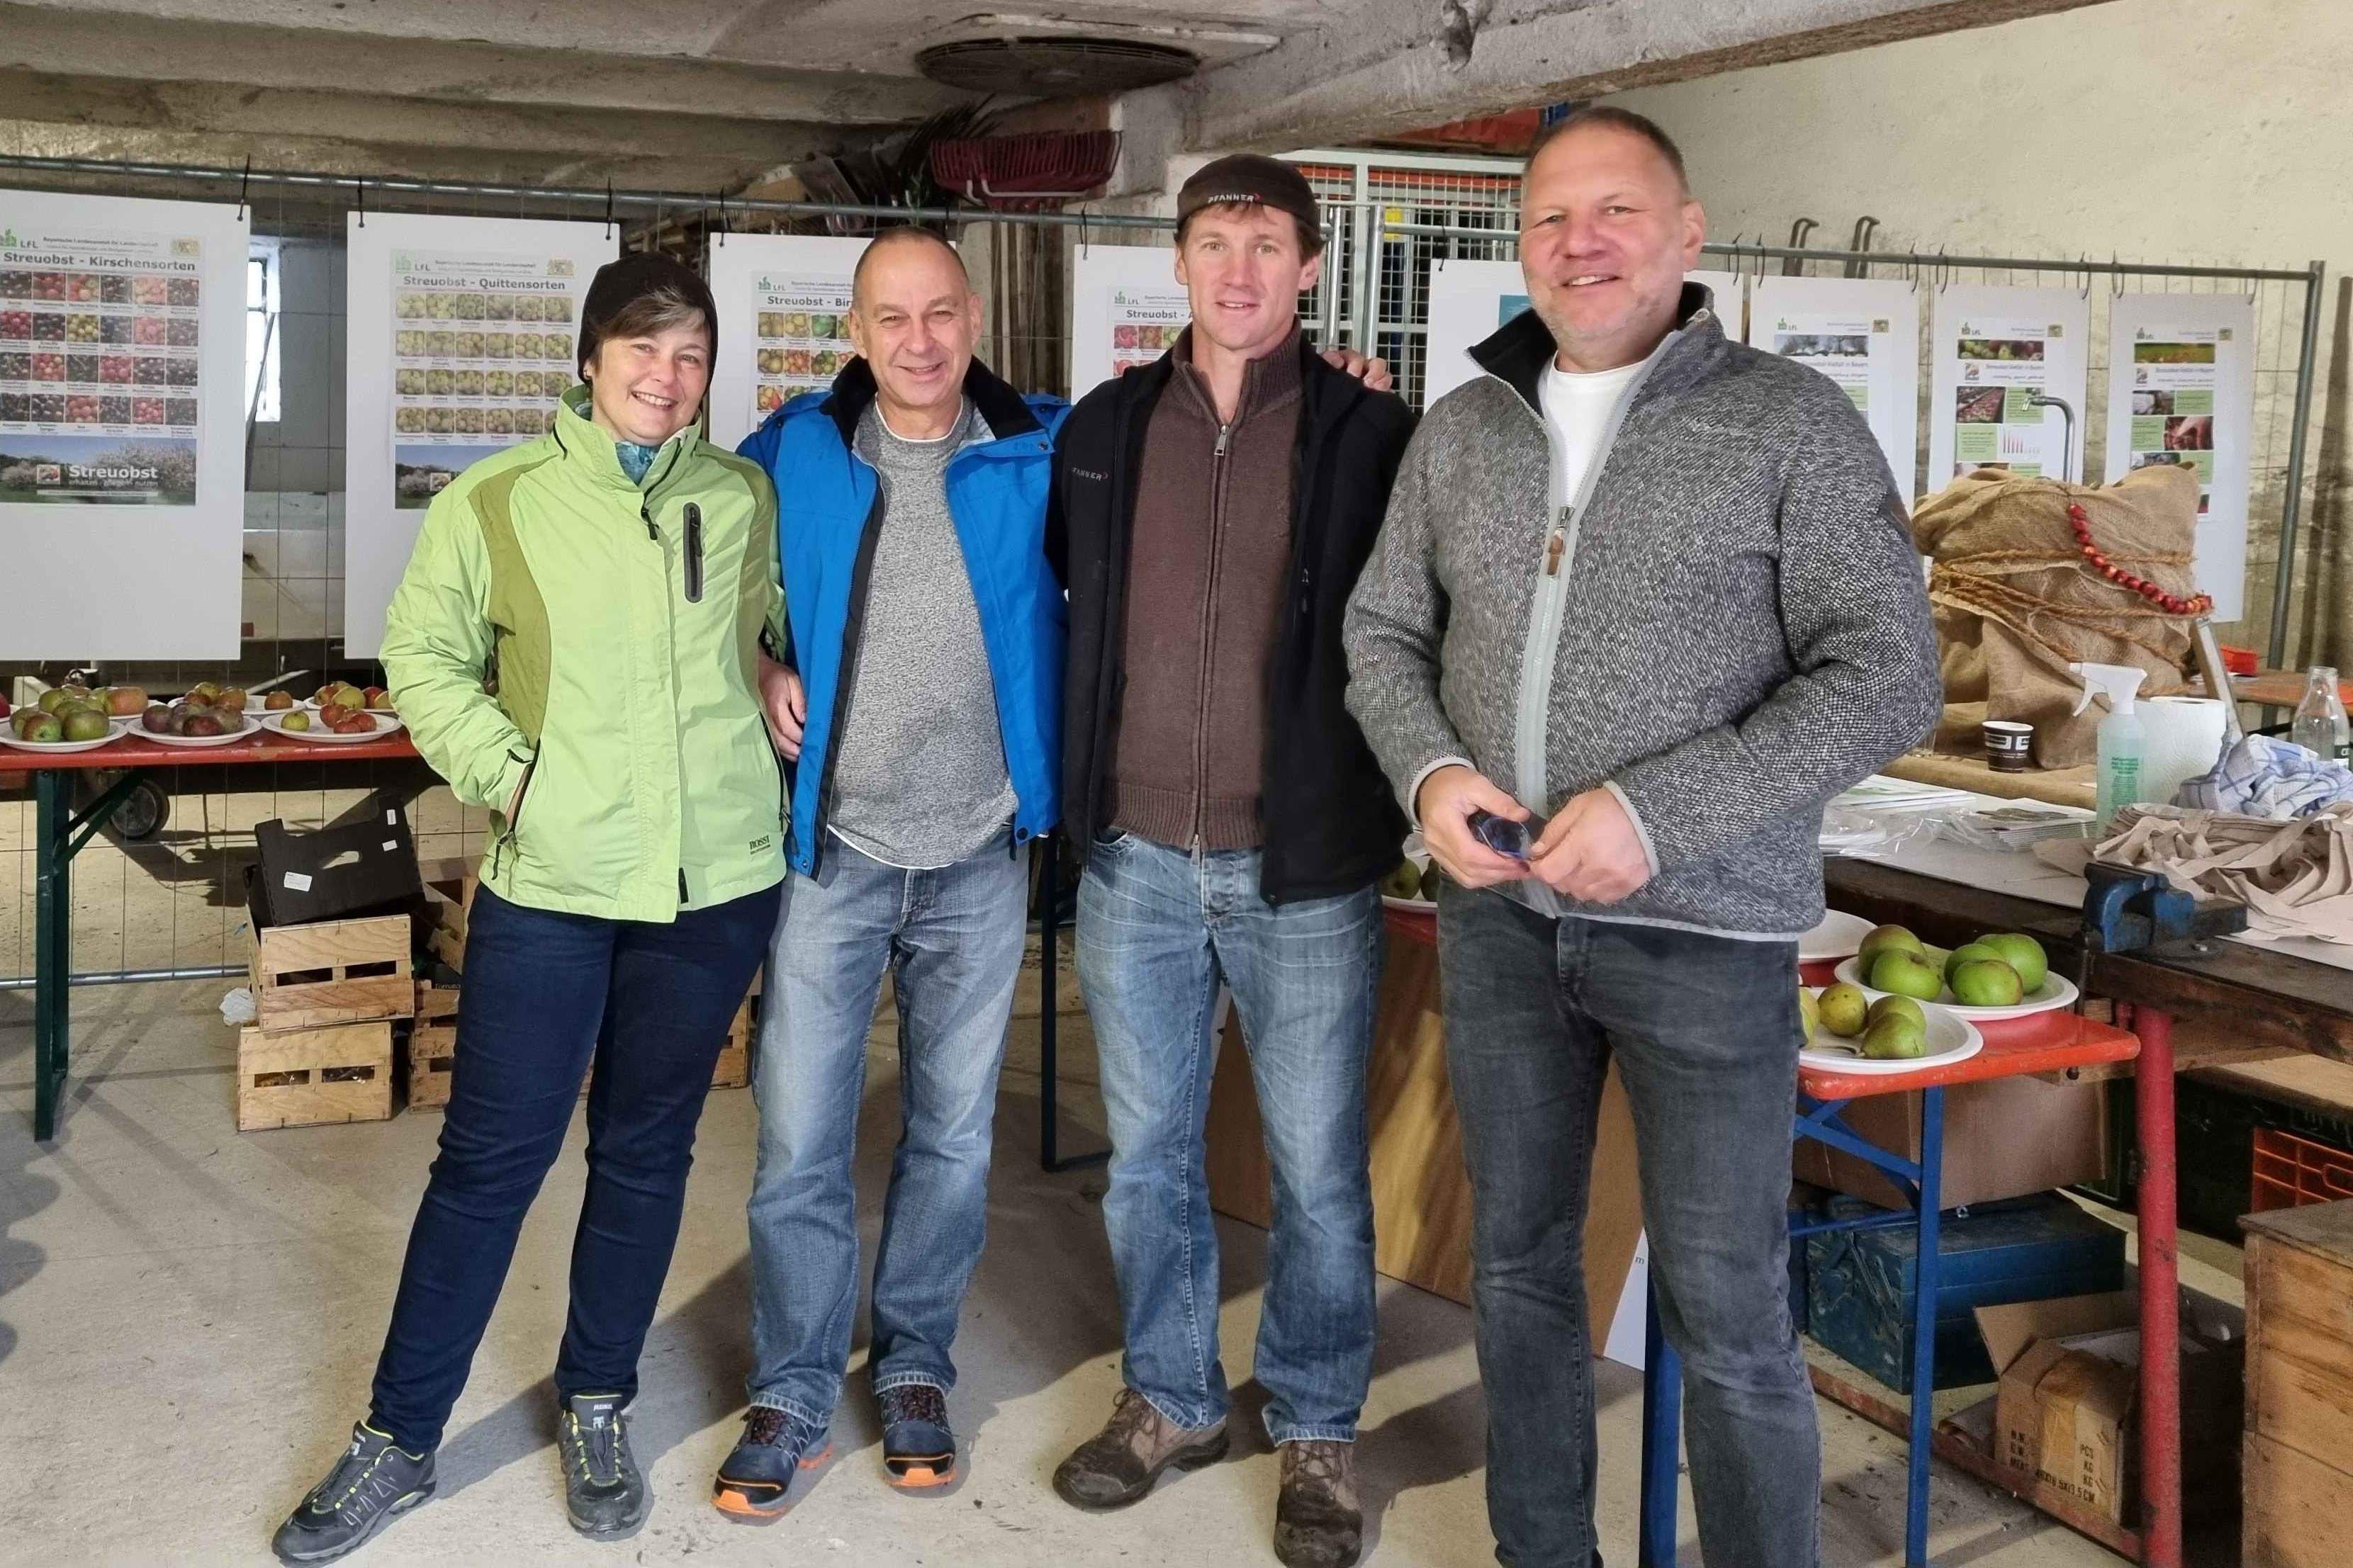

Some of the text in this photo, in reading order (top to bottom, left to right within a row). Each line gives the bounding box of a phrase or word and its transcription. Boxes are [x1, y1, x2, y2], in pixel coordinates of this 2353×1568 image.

[1207, 193, 1254, 204] PFANNER
[4, 252, 74, 265] Streuobst
[89, 255, 196, 271] Kirschensorten
[403, 275, 466, 287] Streuobst
[479, 278, 566, 290] Quittensorten
[767, 295, 824, 306] Streuobst
[1126, 309, 1177, 319] Streuobst
[69, 465, 159, 479] Streuobst
